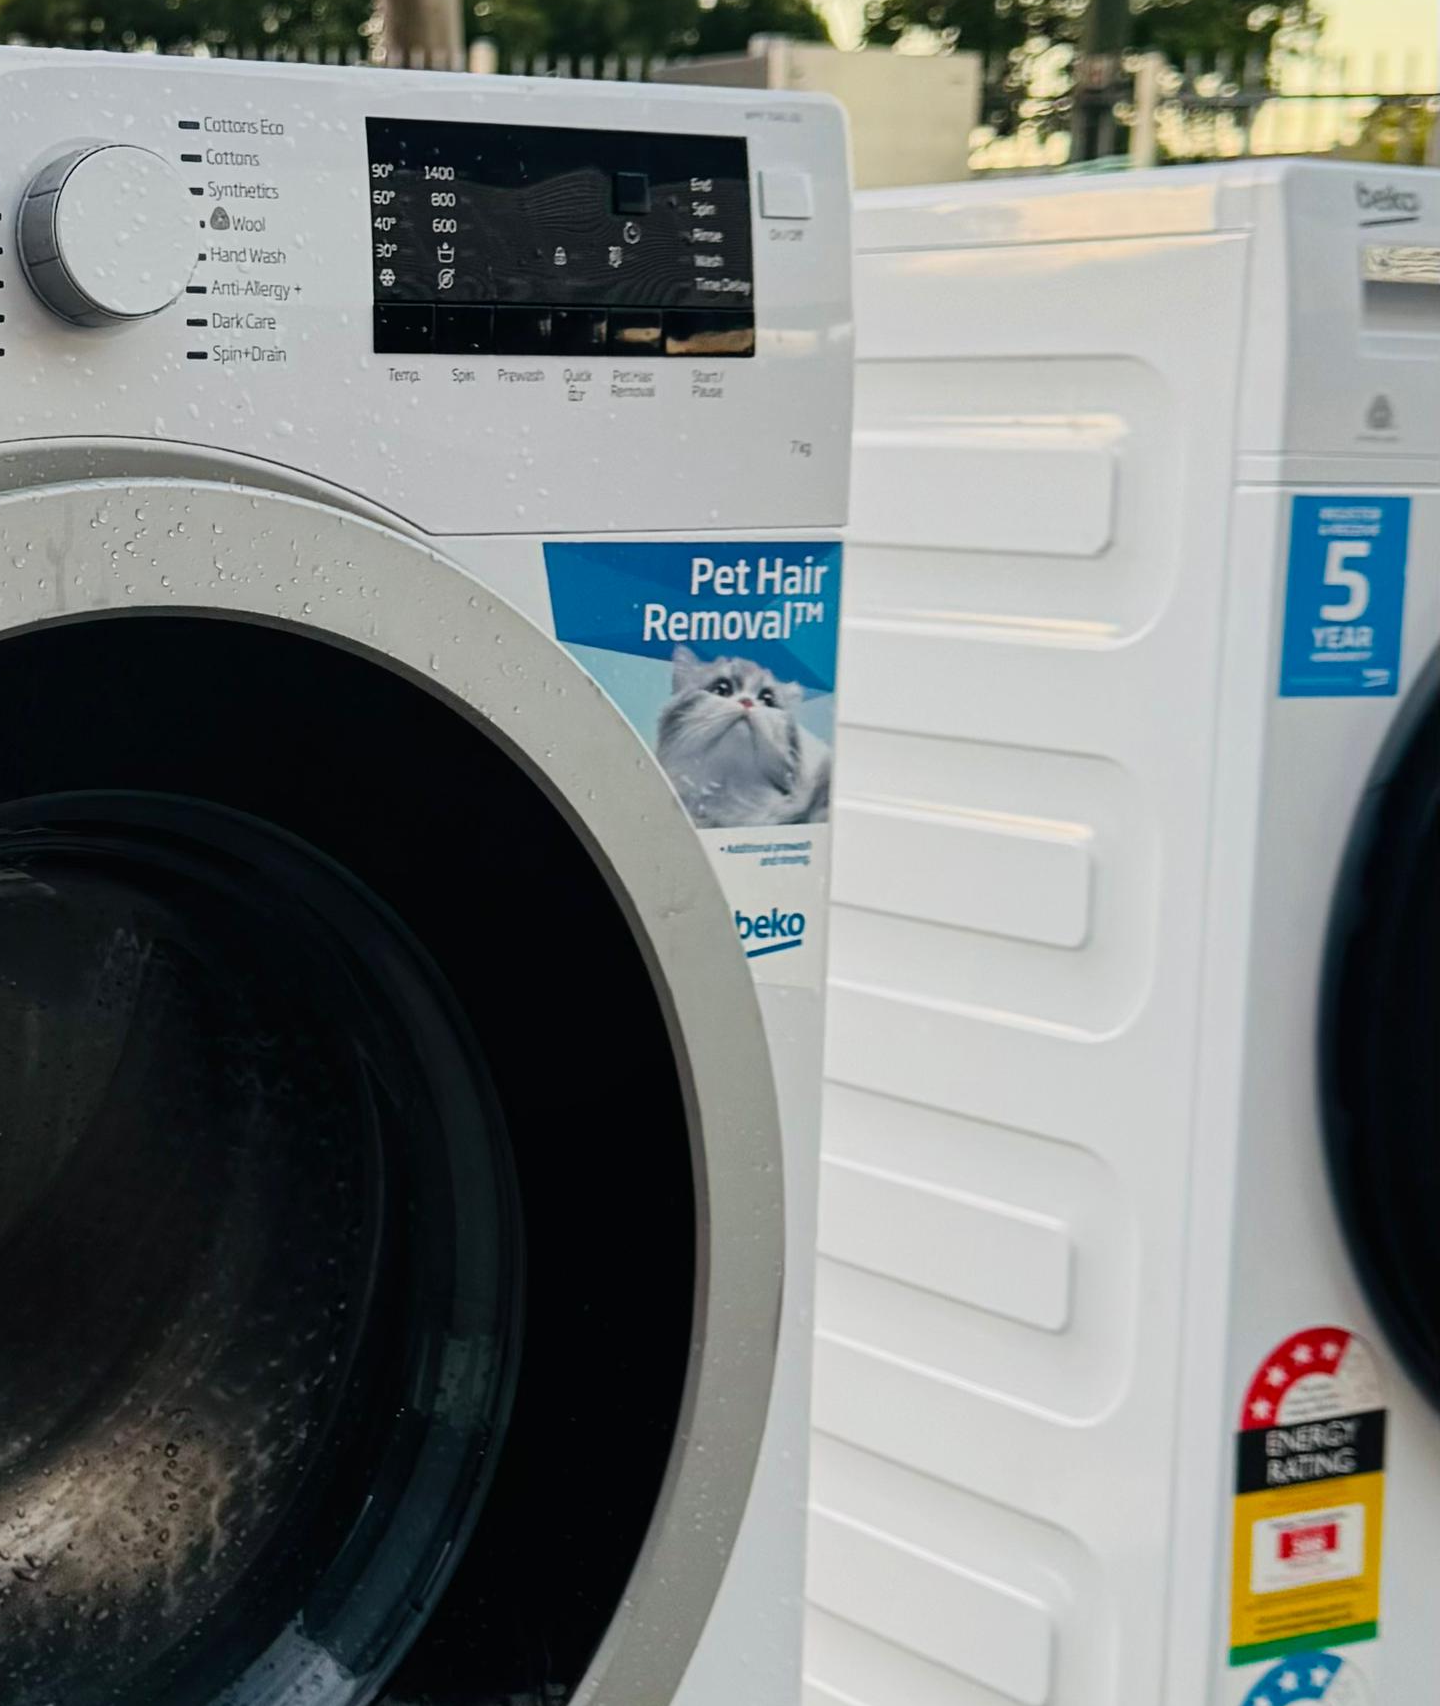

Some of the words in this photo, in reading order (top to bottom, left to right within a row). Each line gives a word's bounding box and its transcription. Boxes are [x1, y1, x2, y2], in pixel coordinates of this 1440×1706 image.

[204, 116, 259, 135] Cottons
[260, 119, 284, 135] Eco
[206, 148, 260, 167] Cottons
[371, 163, 394, 178] 90°
[424, 165, 455, 181] 1400
[207, 181, 280, 201] Synthetics
[430, 192, 456, 207] 800
[232, 214, 266, 232] Wool
[374, 216, 397, 231] 40°
[432, 218, 458, 233] 600
[210, 247, 247, 263] Hand
[249, 247, 287, 264] Wash
[375, 243, 398, 258] 30°
[211, 280, 291, 301] Anti-Allergy
[212, 312, 244, 329] Dark
[245, 313, 277, 330] Care
[212, 344, 287, 365] Spin+Drain
[691, 557, 751, 597] Pet
[756, 555, 829, 596] Hair
[1319, 541, 1372, 623] 5
[1311, 626, 1374, 649] YEAR
[735, 907, 806, 940] beko
[1265, 1419, 1359, 1457] ENERGY
[1265, 1446, 1359, 1485] RATING
